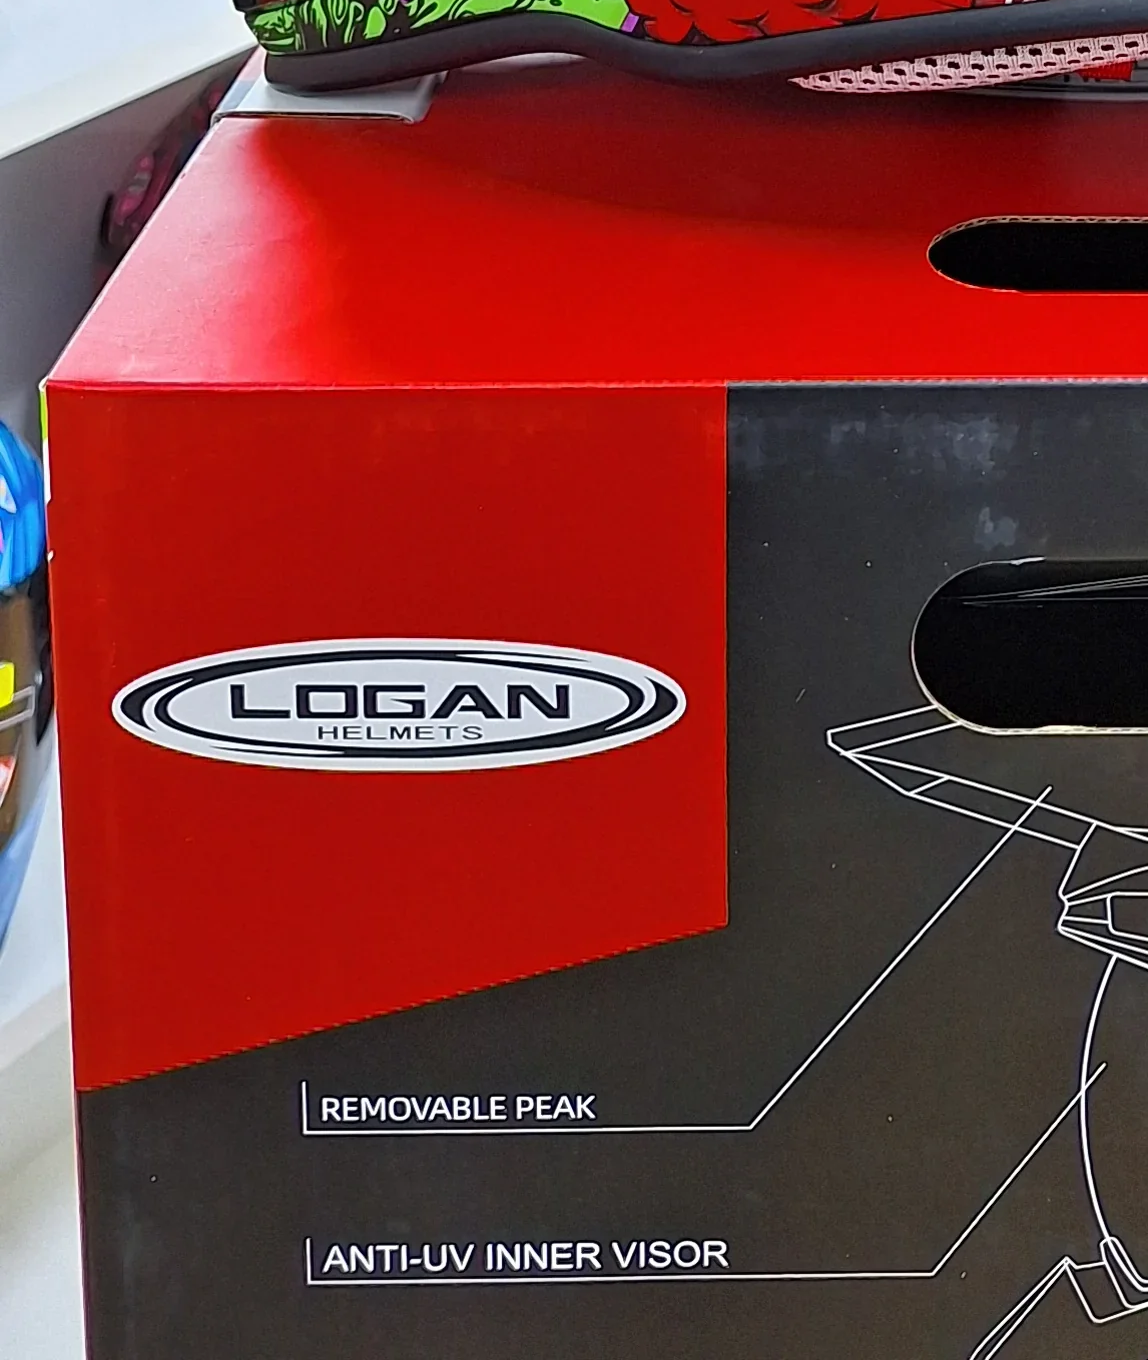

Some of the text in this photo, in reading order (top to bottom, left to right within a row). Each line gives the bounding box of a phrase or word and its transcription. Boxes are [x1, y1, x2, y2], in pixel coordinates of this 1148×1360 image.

[230, 684, 570, 720] LOGAN
[317, 725, 484, 741] HELMETS
[321, 1094, 596, 1122] REMOVABLE PEAK
[322, 1240, 730, 1274] ANTI-UV INNER VISOR
